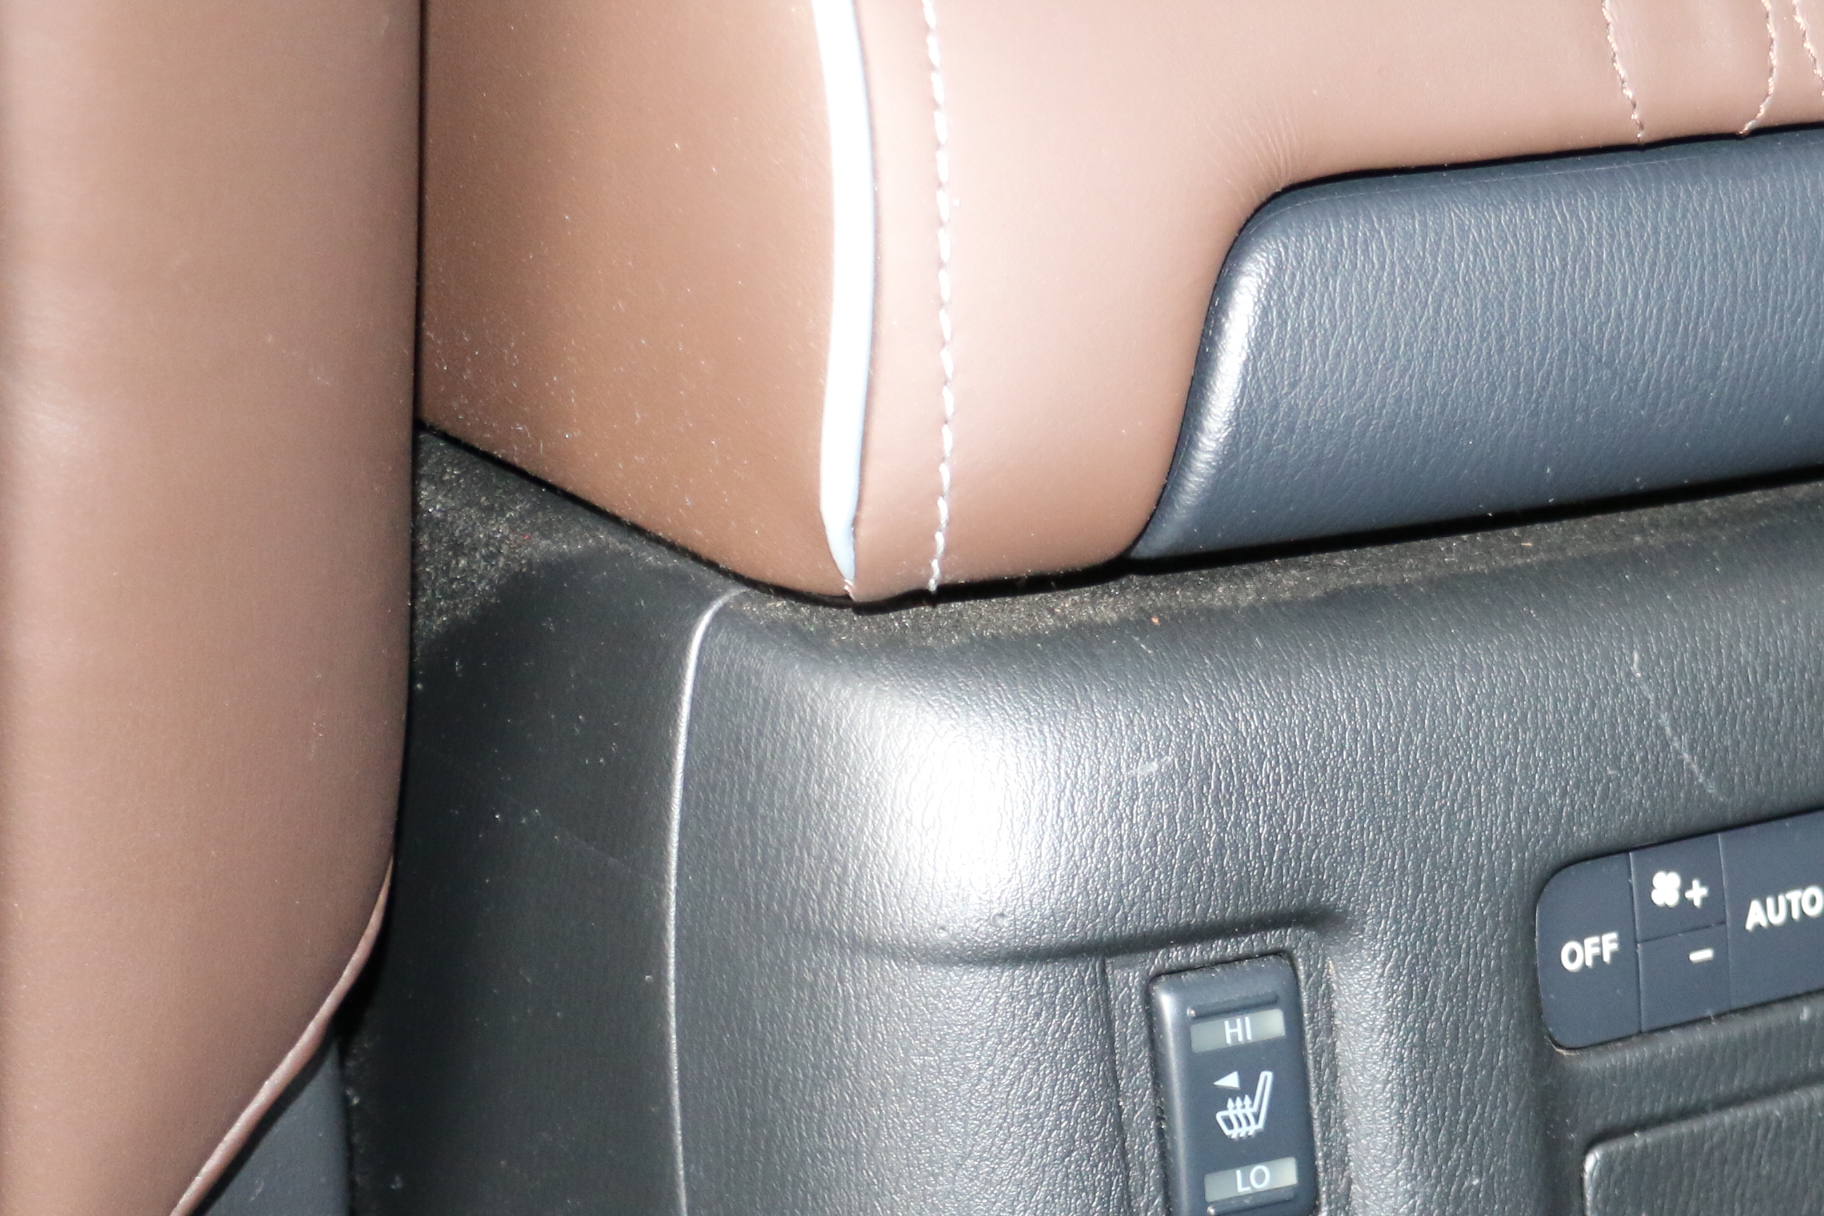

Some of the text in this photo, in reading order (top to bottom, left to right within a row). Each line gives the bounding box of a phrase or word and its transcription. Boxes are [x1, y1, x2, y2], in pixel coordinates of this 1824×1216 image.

[1560, 931, 1620, 973] OFF
[1223, 1015, 1252, 1045] HI
[1235, 1164, 1271, 1193] LO
